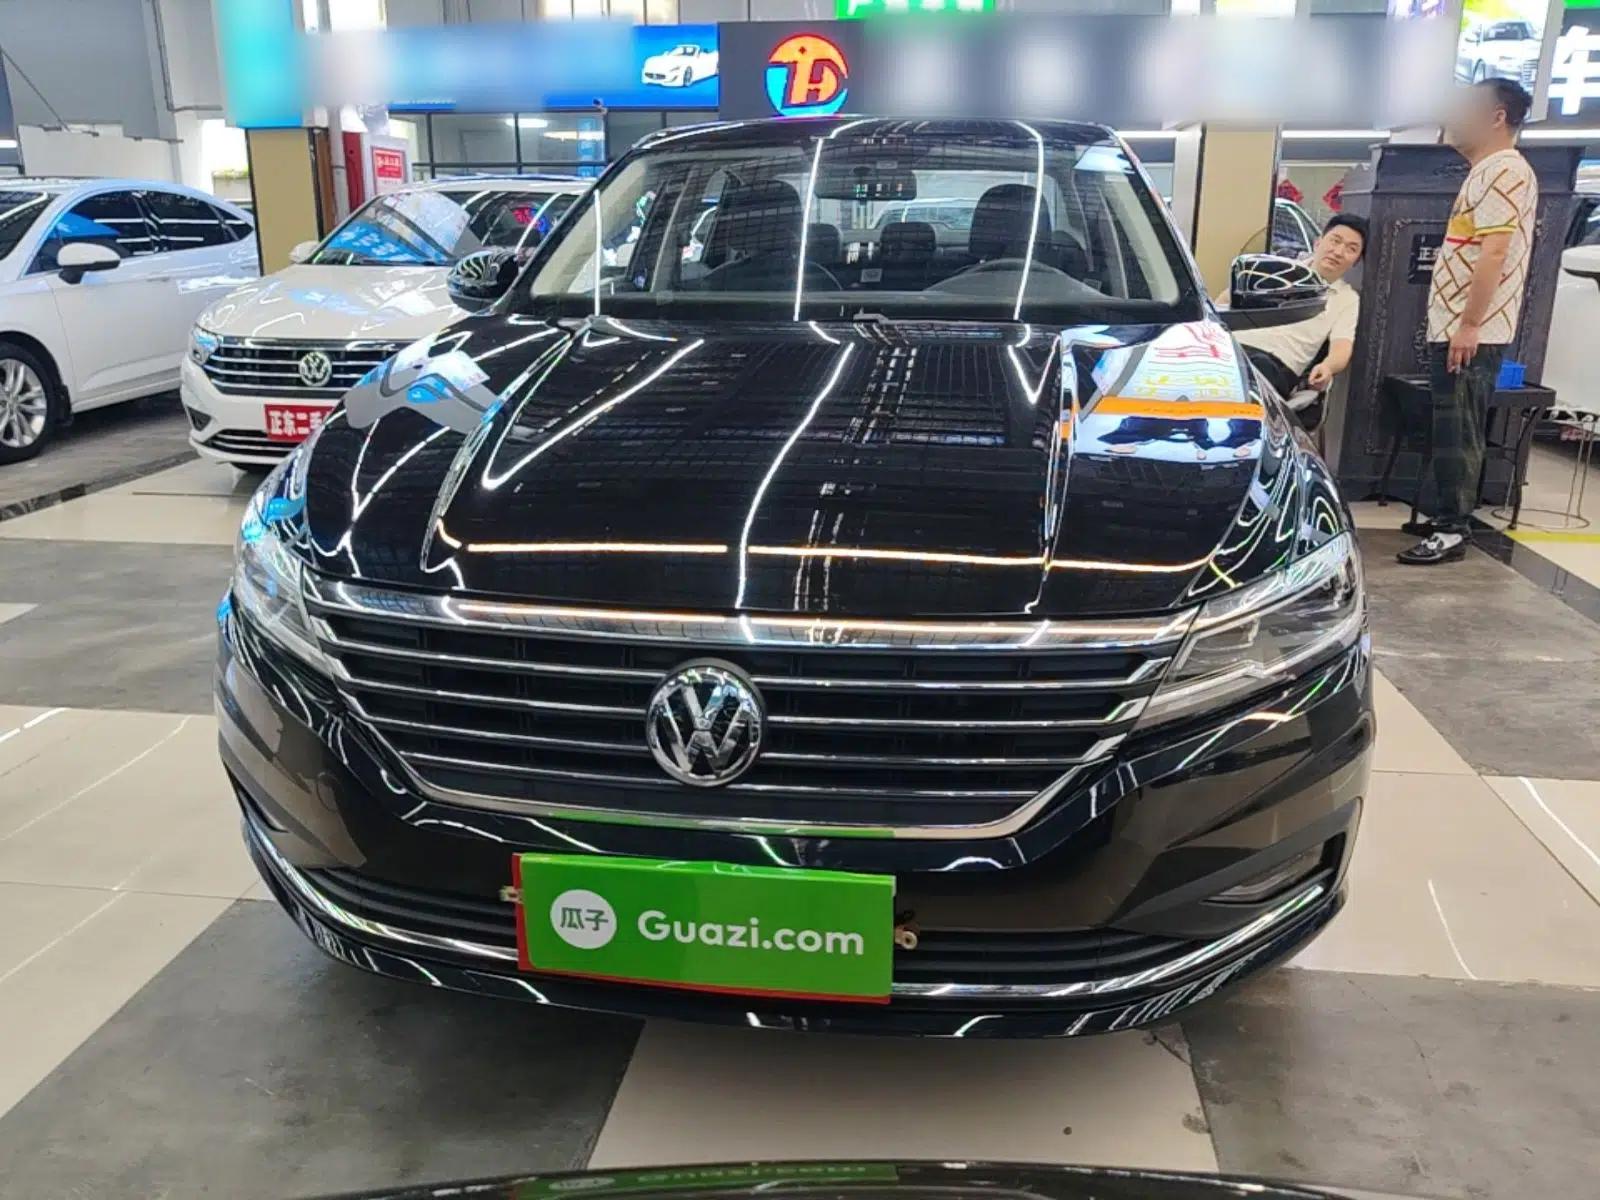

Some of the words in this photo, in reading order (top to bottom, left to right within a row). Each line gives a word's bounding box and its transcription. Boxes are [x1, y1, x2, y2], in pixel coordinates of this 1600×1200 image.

[1548, 25, 1600, 115] 车
[268, 410, 331, 436] 正东二手
[560, 907, 609, 931] 瓜子
[637, 910, 864, 955] Guazi.com
